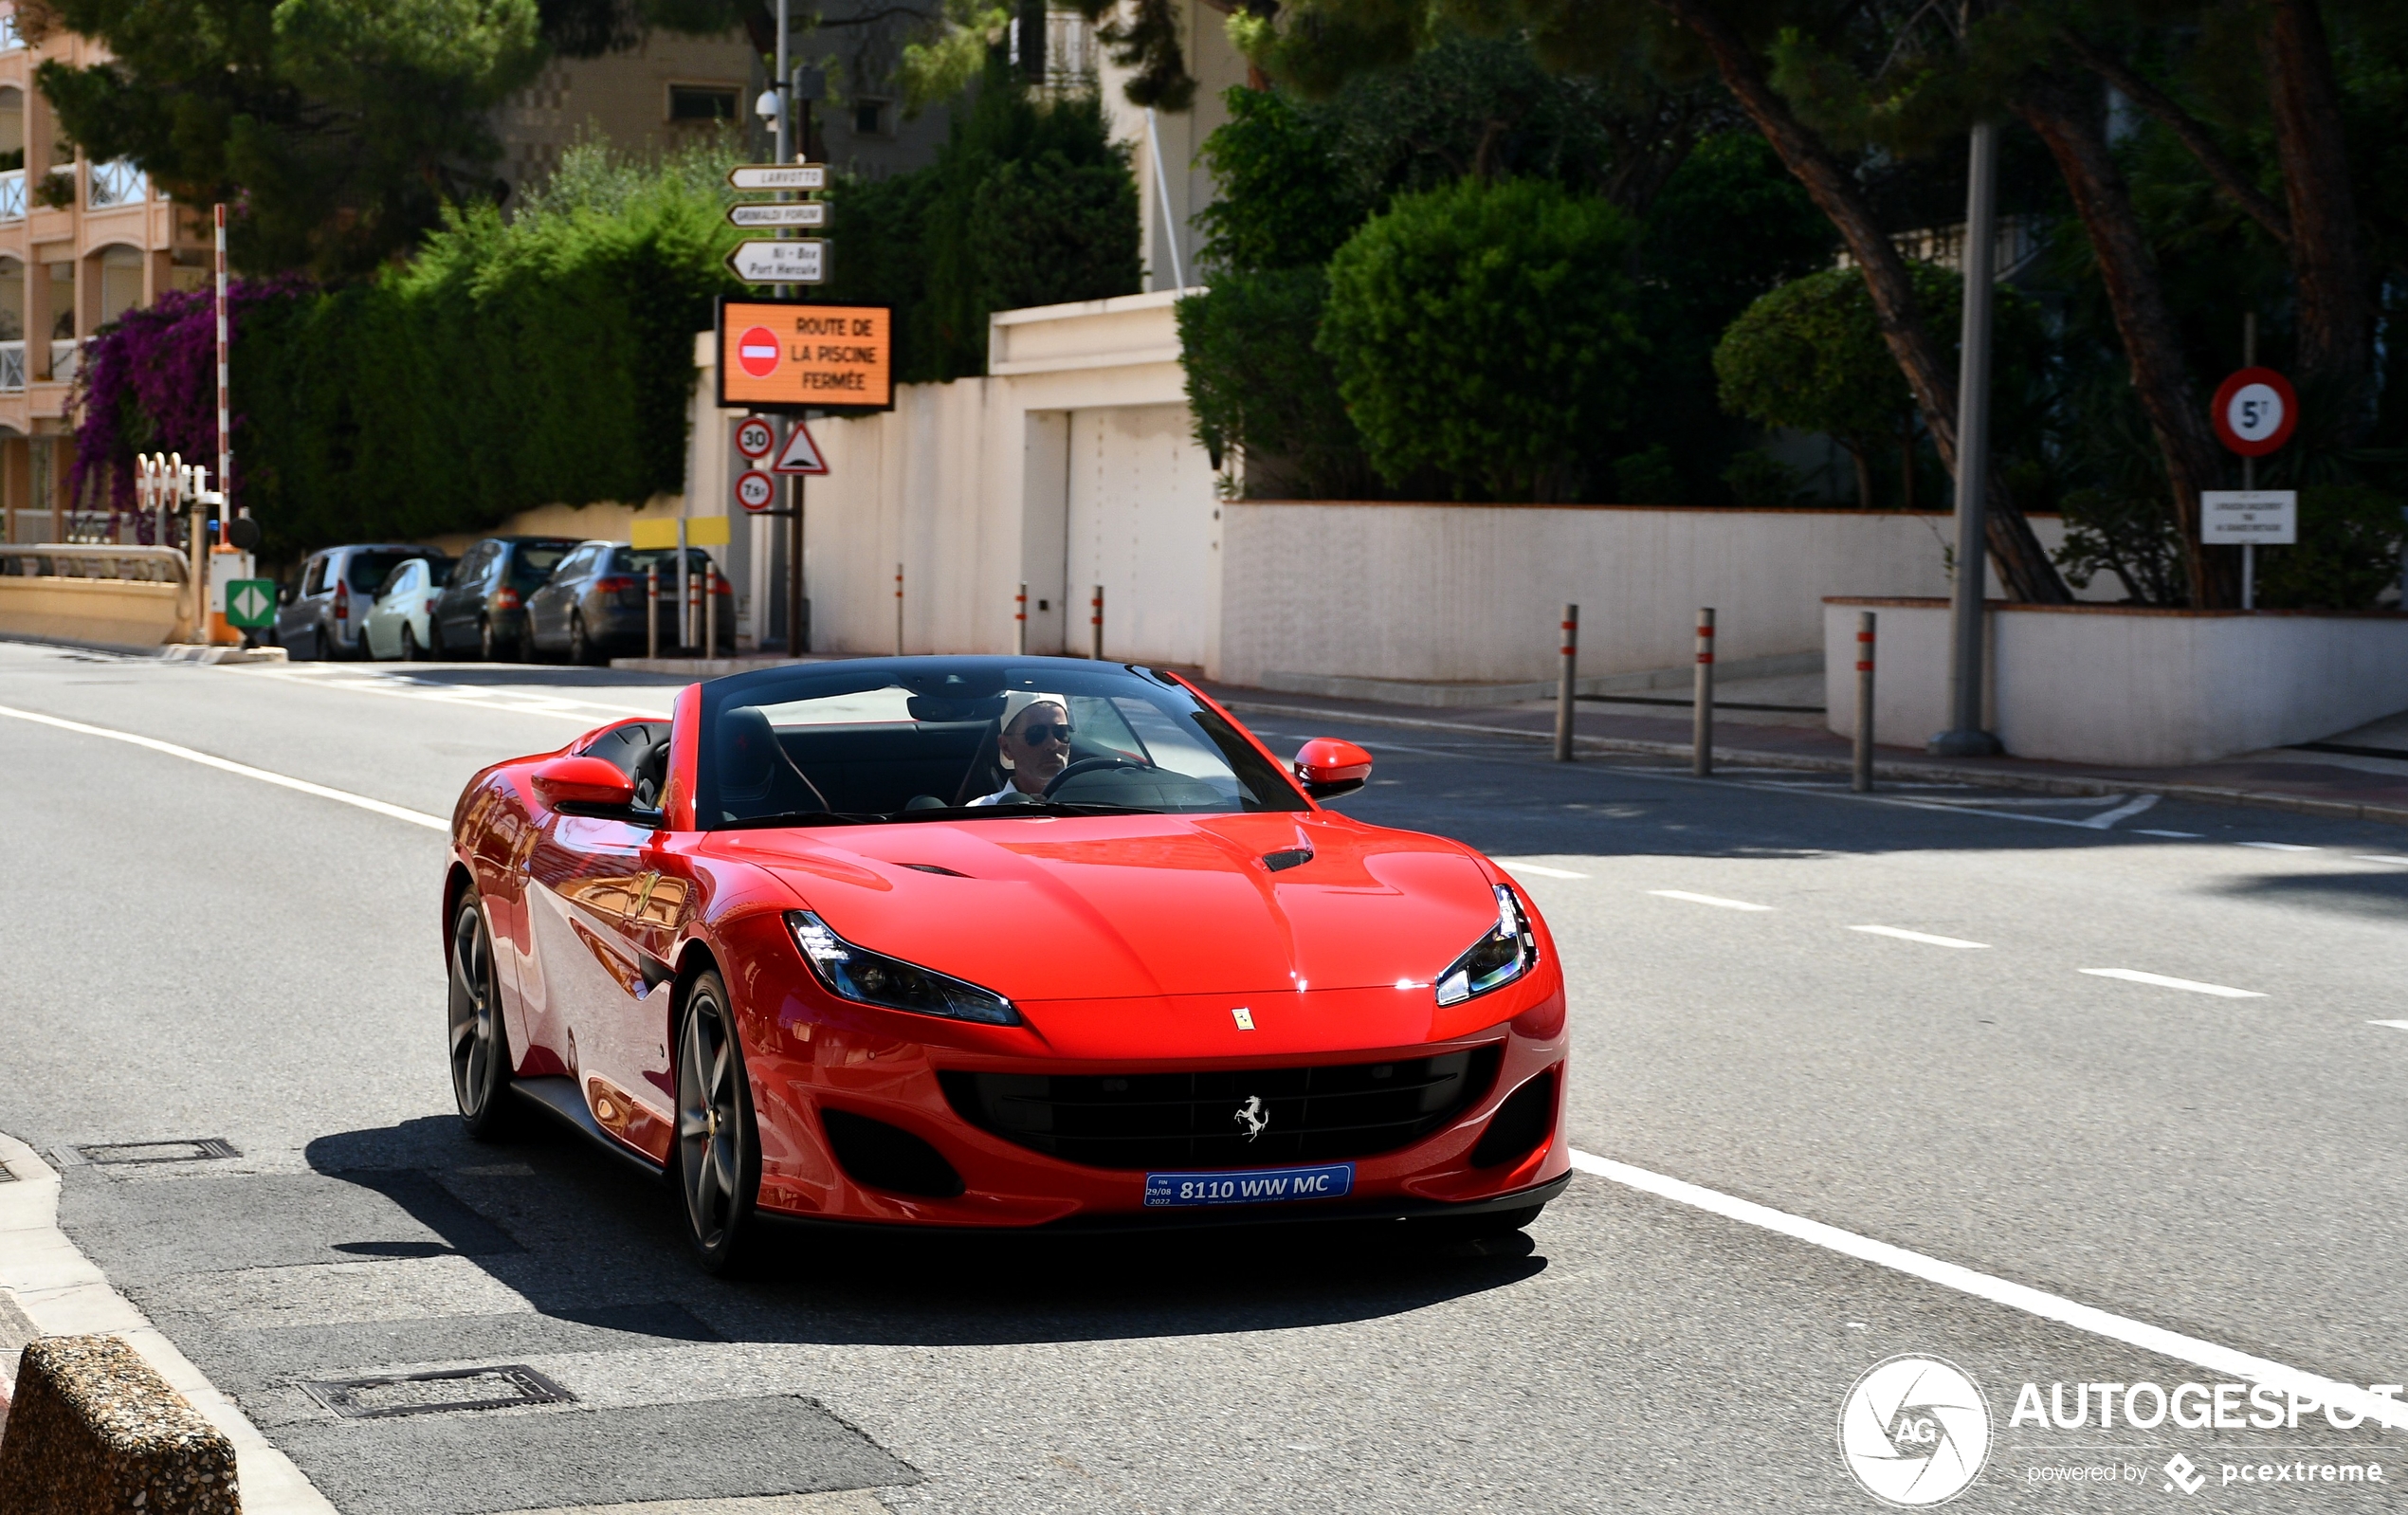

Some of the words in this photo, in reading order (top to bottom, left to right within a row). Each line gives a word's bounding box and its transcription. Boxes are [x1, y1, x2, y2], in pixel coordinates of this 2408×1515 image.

[761, 172, 818, 184] LARVOTTO
[737, 210, 781, 222] GRIMALDI
[784, 209, 818, 220] FORUM
[750, 263, 773, 275] Port
[776, 262, 817, 275] Hercule
[796, 318, 846, 337] ROUTE
[852, 319, 873, 337] DE
[792, 345, 812, 362] LA
[818, 346, 877, 364] PISCINE
[803, 370, 866, 390] FERMÉE
[744, 430, 766, 447] 30
[1147, 1187, 1172, 1196] 29/08
[1179, 1181, 1234, 1199] 8110
[1240, 1177, 1288, 1197] WW
[1293, 1175, 1330, 1194] MC
